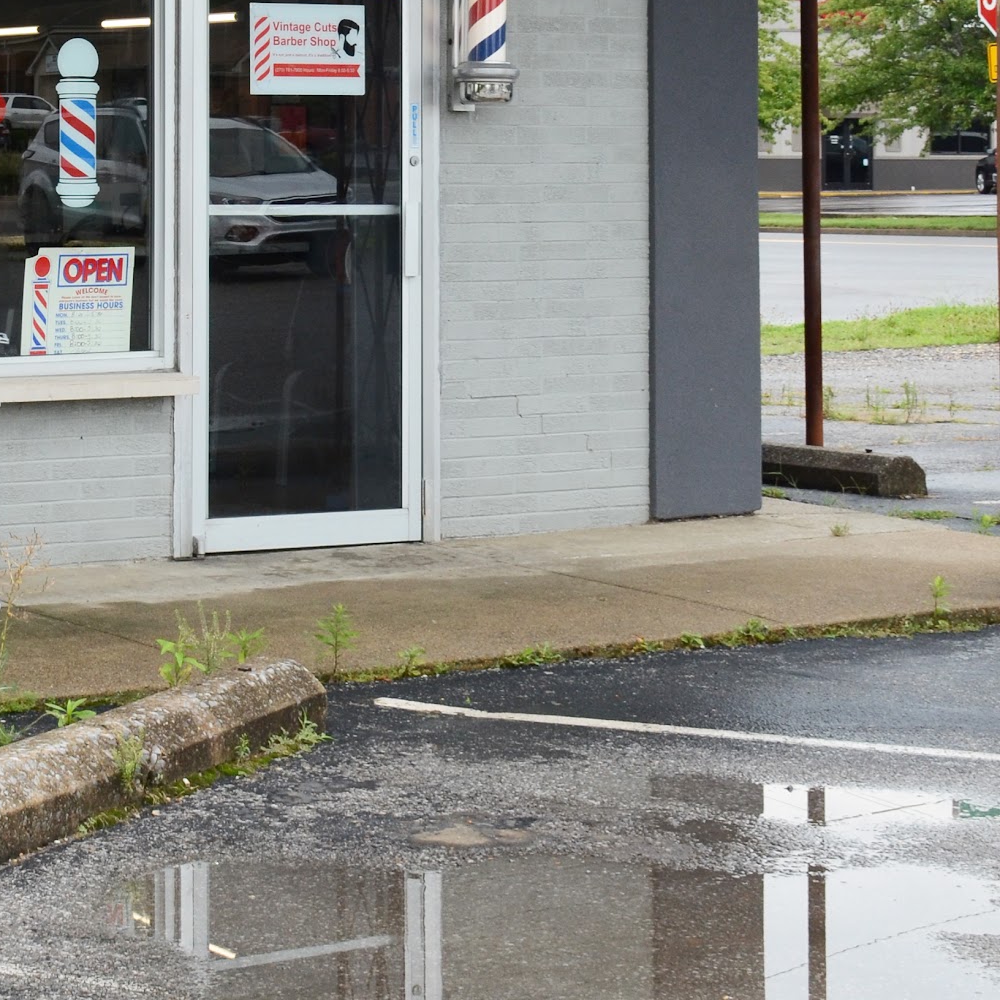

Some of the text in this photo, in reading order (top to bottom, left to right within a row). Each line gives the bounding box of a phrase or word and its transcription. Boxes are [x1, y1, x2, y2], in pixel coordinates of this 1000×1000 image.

[272, 22, 338, 34] Vintage Cuts
[273, 36, 337, 49] Barber Shop
[63, 257, 124, 284] OPEN
[75, 287, 108, 296] WELCOME
[58, 302, 95, 310] BUSINESS
[97, 301, 124, 309] HOURS
